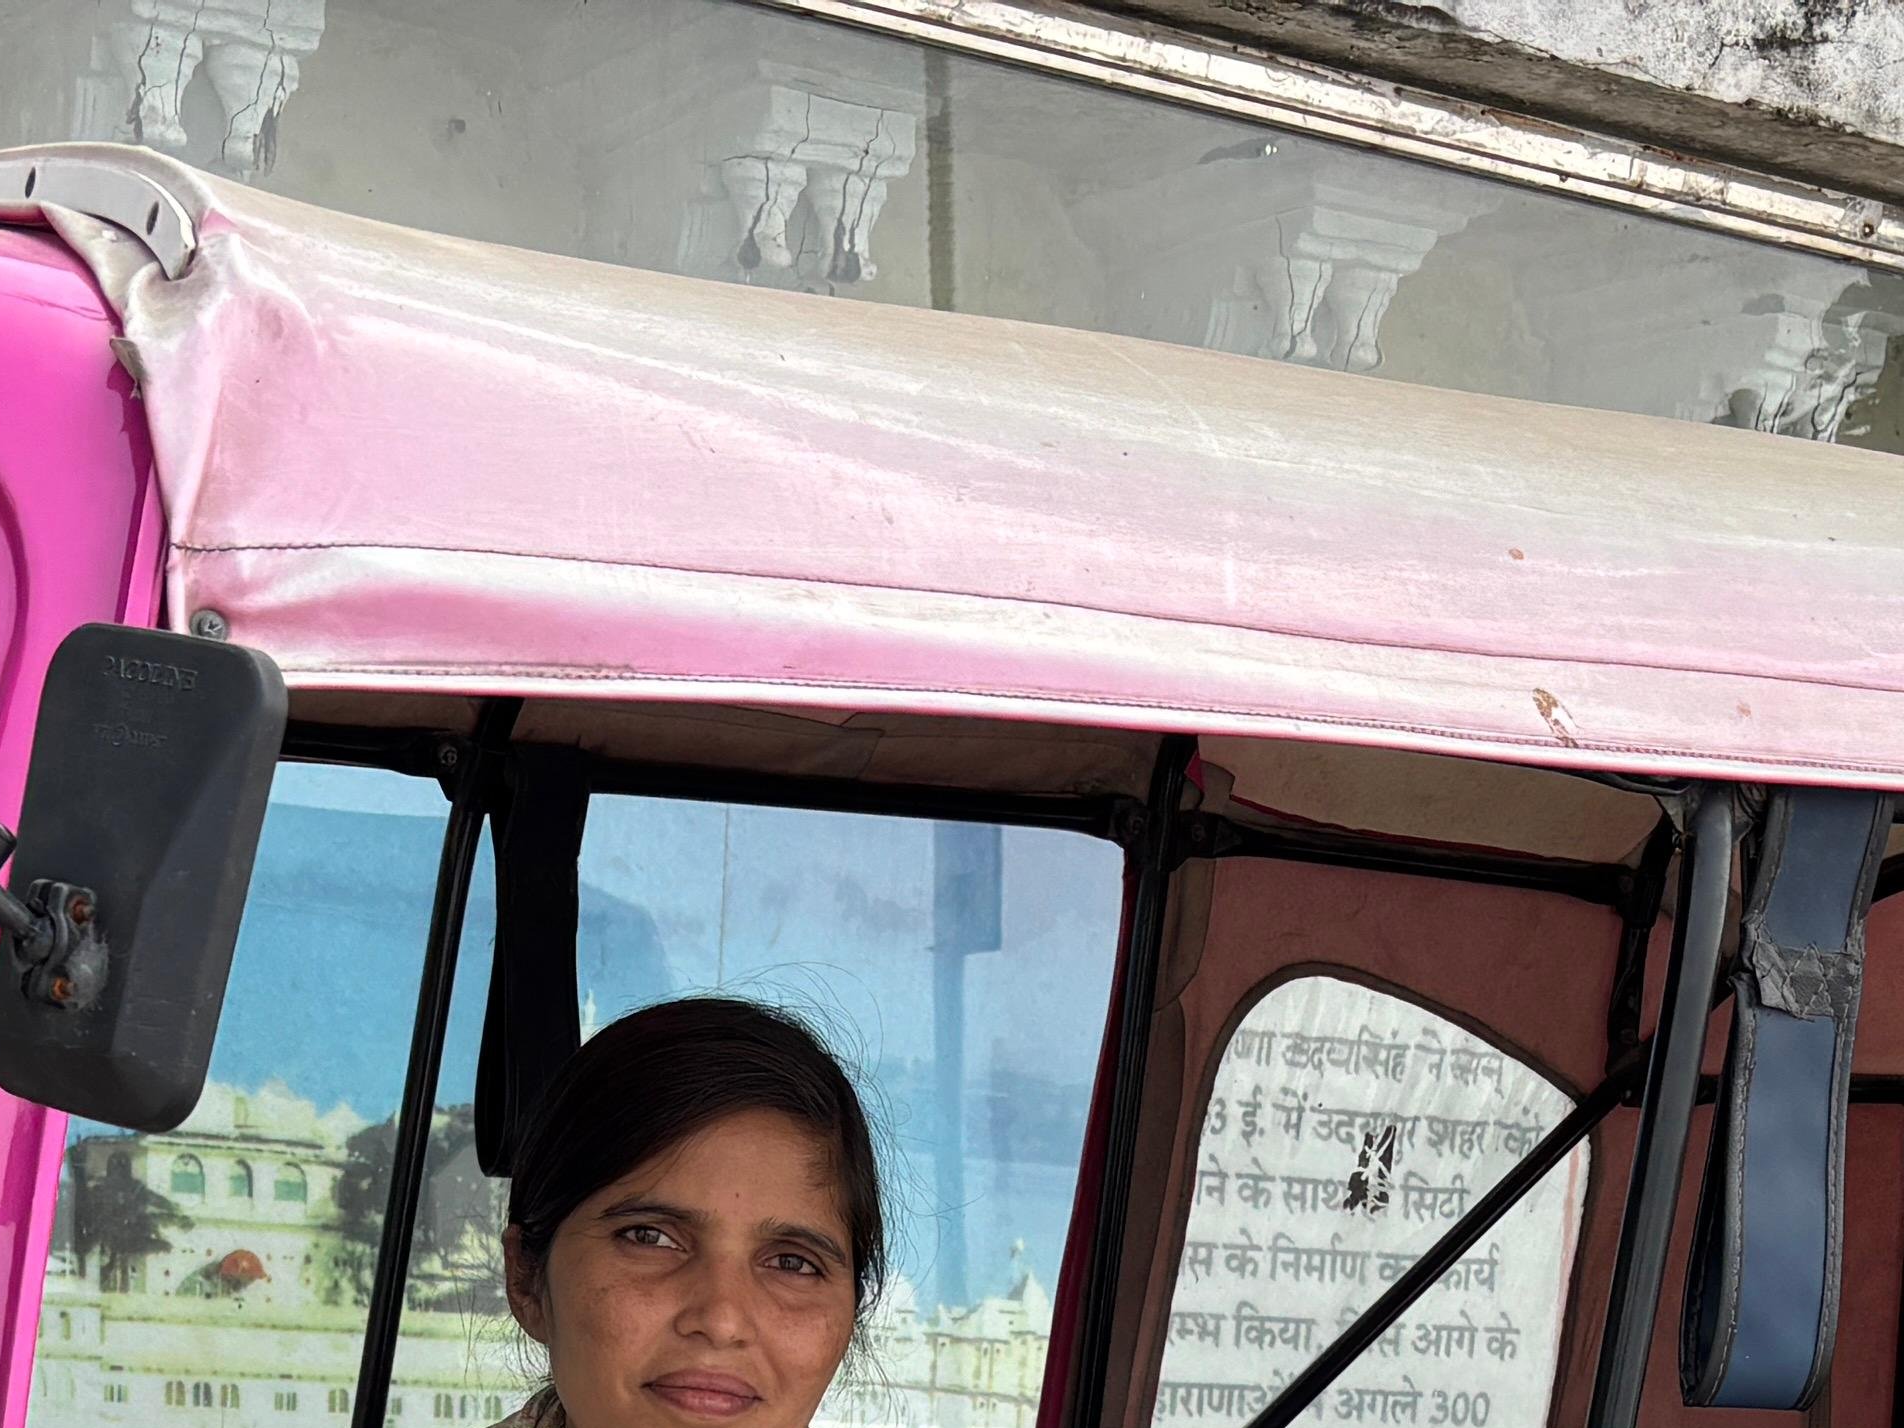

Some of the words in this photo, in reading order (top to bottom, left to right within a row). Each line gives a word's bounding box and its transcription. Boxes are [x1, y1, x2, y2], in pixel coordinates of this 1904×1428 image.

[1425, 1115, 1490, 1157] शहर
[1234, 1157, 1277, 1209] के
[1400, 1170, 1471, 1223] सिटी
[1222, 1227, 1264, 1280] के
[1268, 1231, 1370, 1285] निर्माण
[1410, 1309, 1478, 1359] आगे
[1483, 1311, 1522, 1362] के
[1333, 1374, 1424, 1425] अगले
[1429, 1389, 1492, 1428] 300
